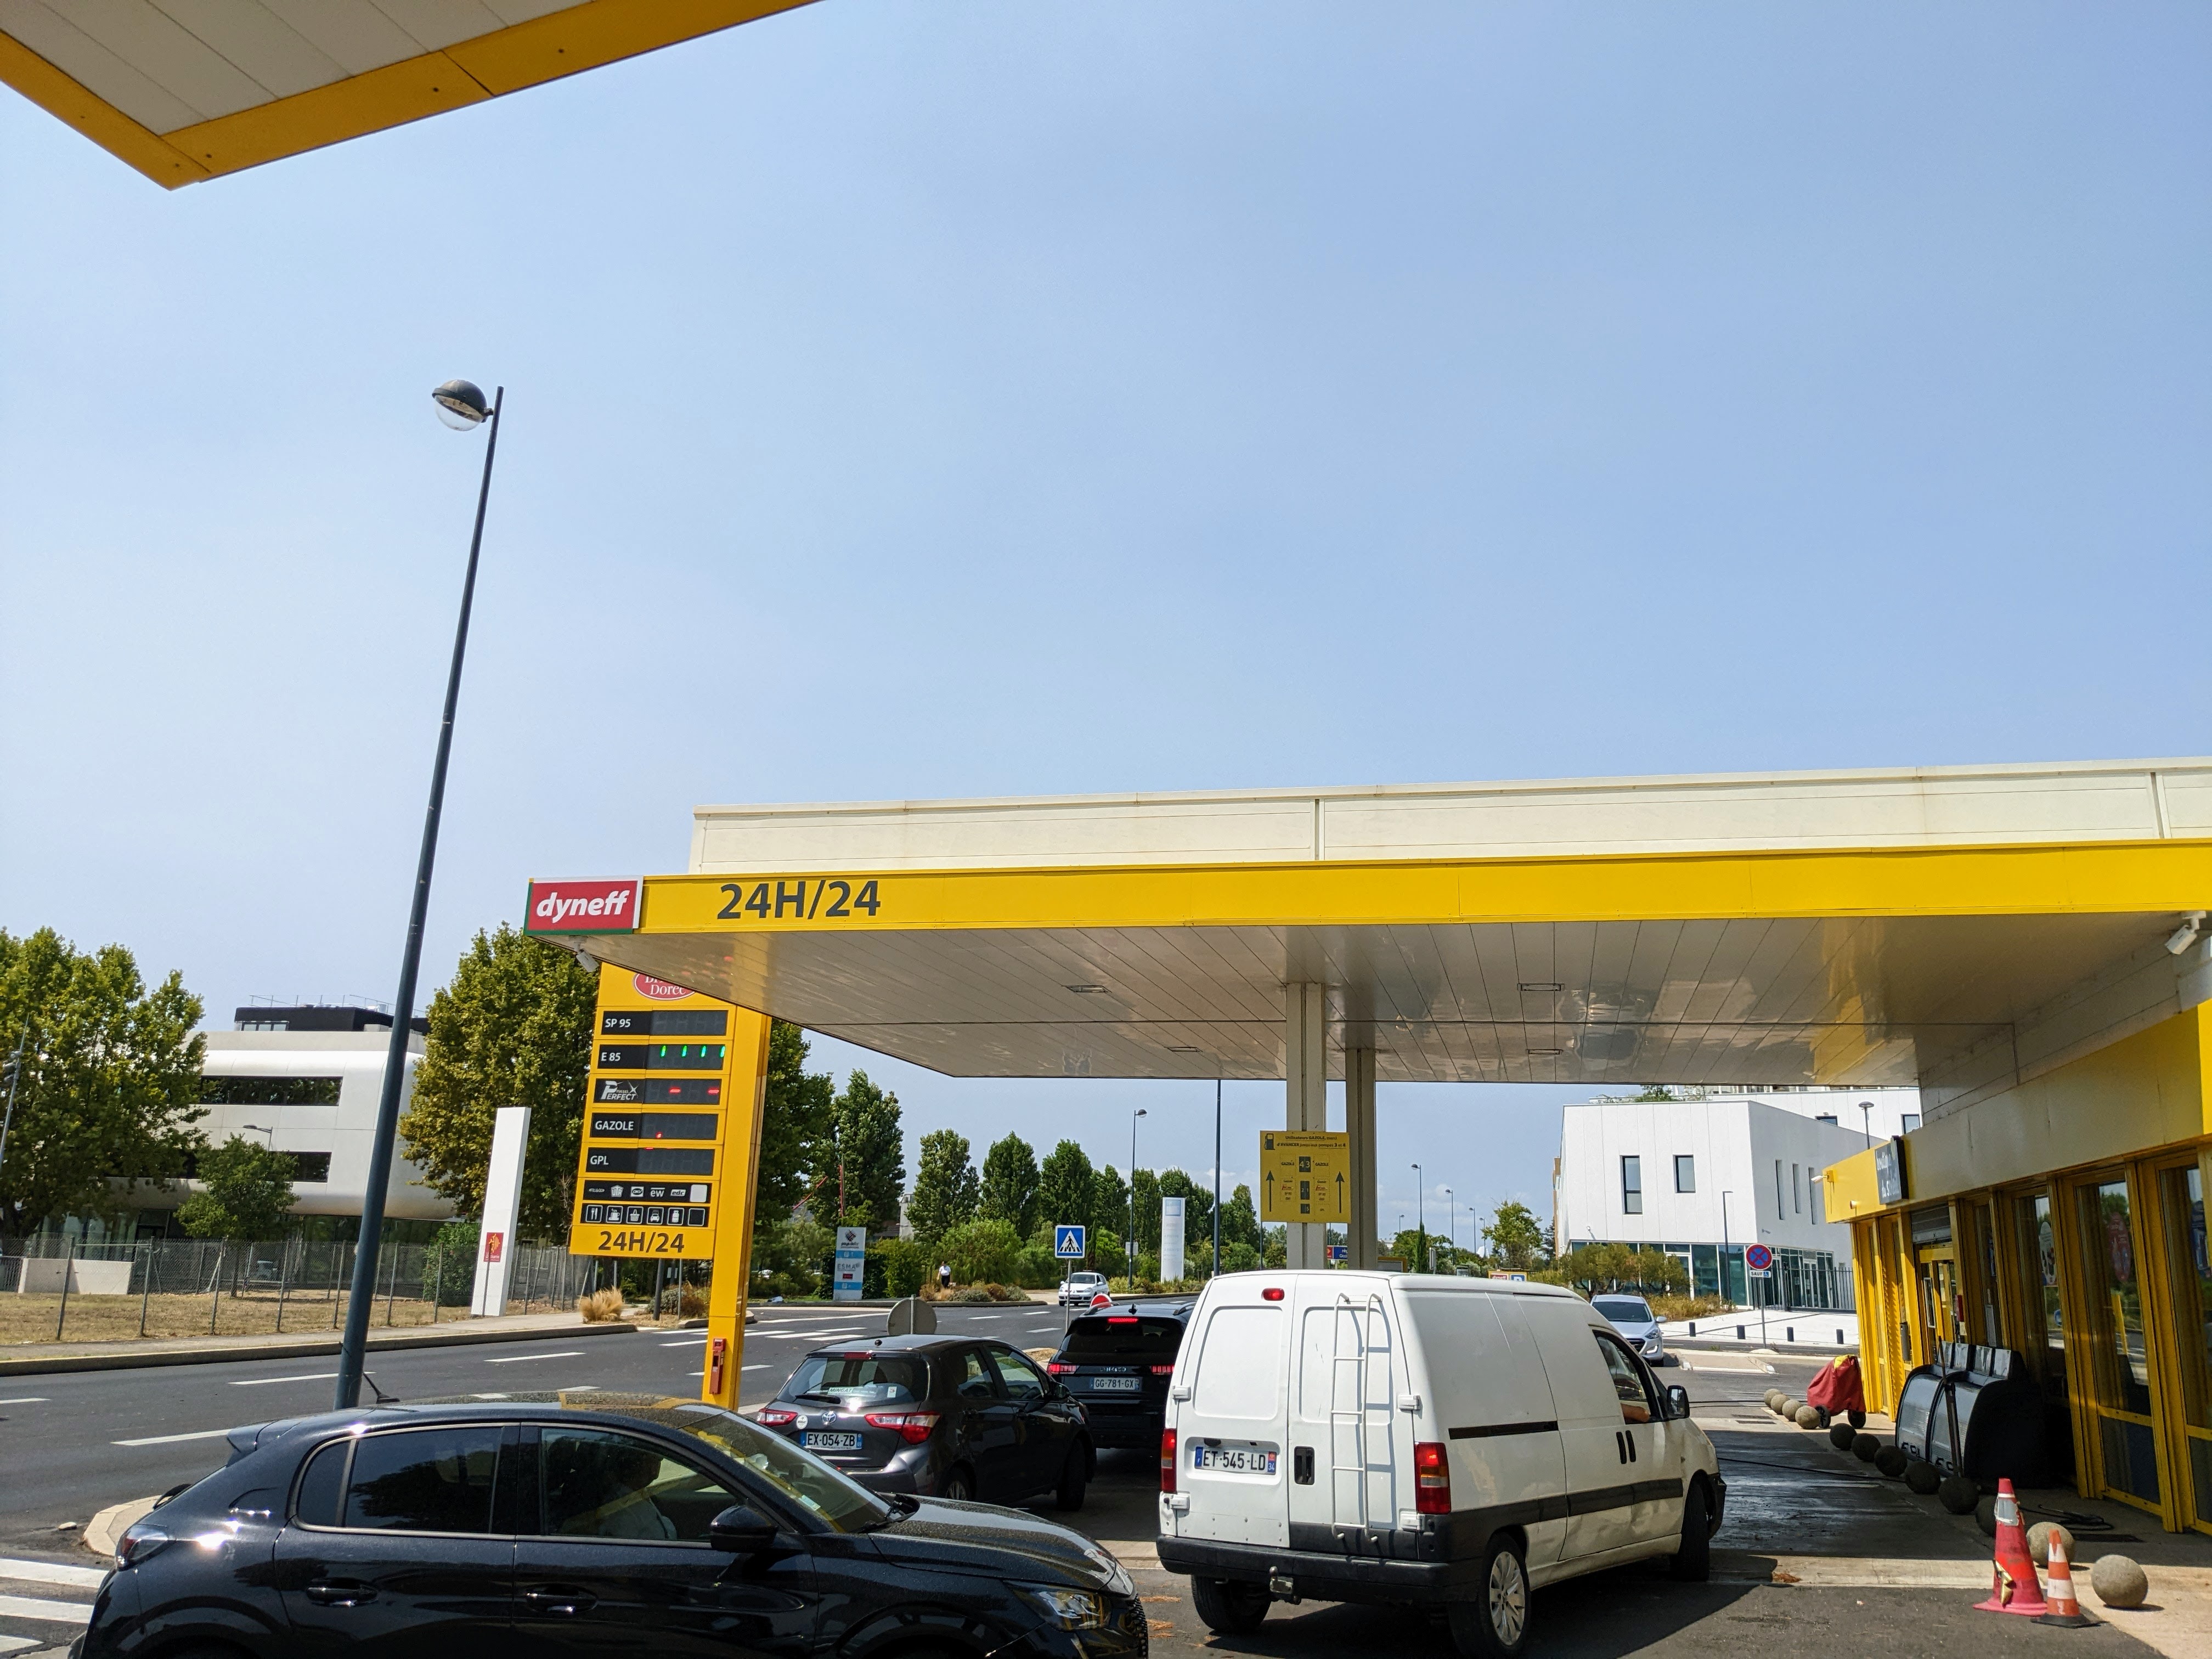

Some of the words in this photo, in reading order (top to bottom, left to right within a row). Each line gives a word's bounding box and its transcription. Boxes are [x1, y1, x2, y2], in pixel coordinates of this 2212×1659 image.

[716, 879, 881, 921] 24H/24
[536, 890, 630, 924] dyneff
[605, 1018, 618, 1028] SP
[619, 1018, 631, 1028] 95
[601, 1052, 608, 1062] E
[609, 1052, 621, 1062] 85
[601, 1081, 636, 1101] PERFECT
[595, 1120, 634, 1131] GAZOLE
[590, 1155, 609, 1166] GPL
[598, 1231, 685, 1254] 24H/24
[1095, 1379, 1134, 1388] GG-781-GX
[808, 1434, 855, 1447] EX-054-ZB
[1203, 1450, 1266, 1471] ET-545-LD
[1268, 1463, 1274, 1471] 34
